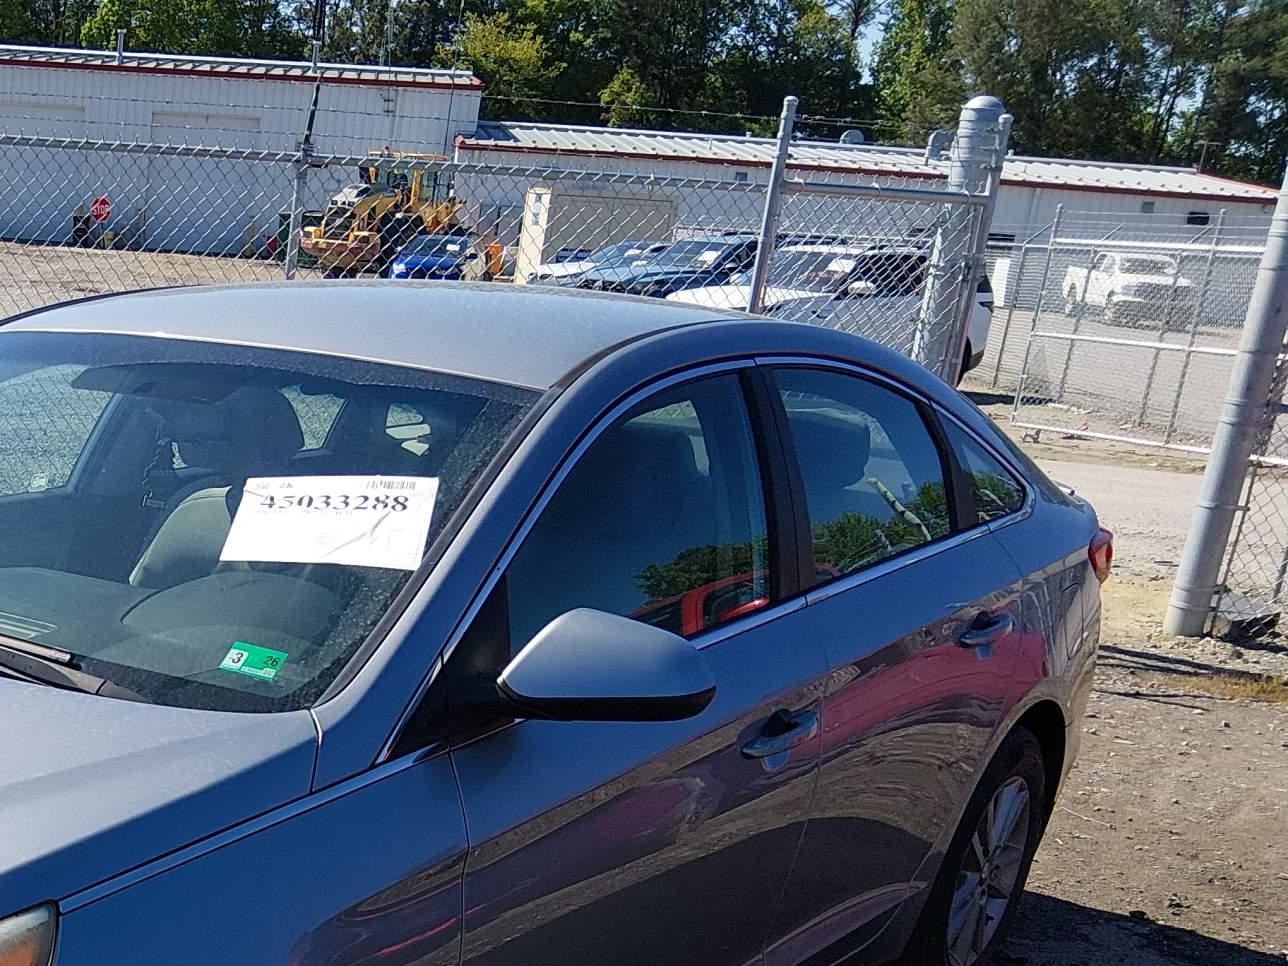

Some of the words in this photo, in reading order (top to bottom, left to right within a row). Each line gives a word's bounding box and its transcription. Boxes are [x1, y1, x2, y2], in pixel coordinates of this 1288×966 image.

[92, 203, 110, 216] STOP
[260, 494, 409, 512] 45033288
[232, 652, 243, 664] 3
[263, 655, 280, 667] 26
